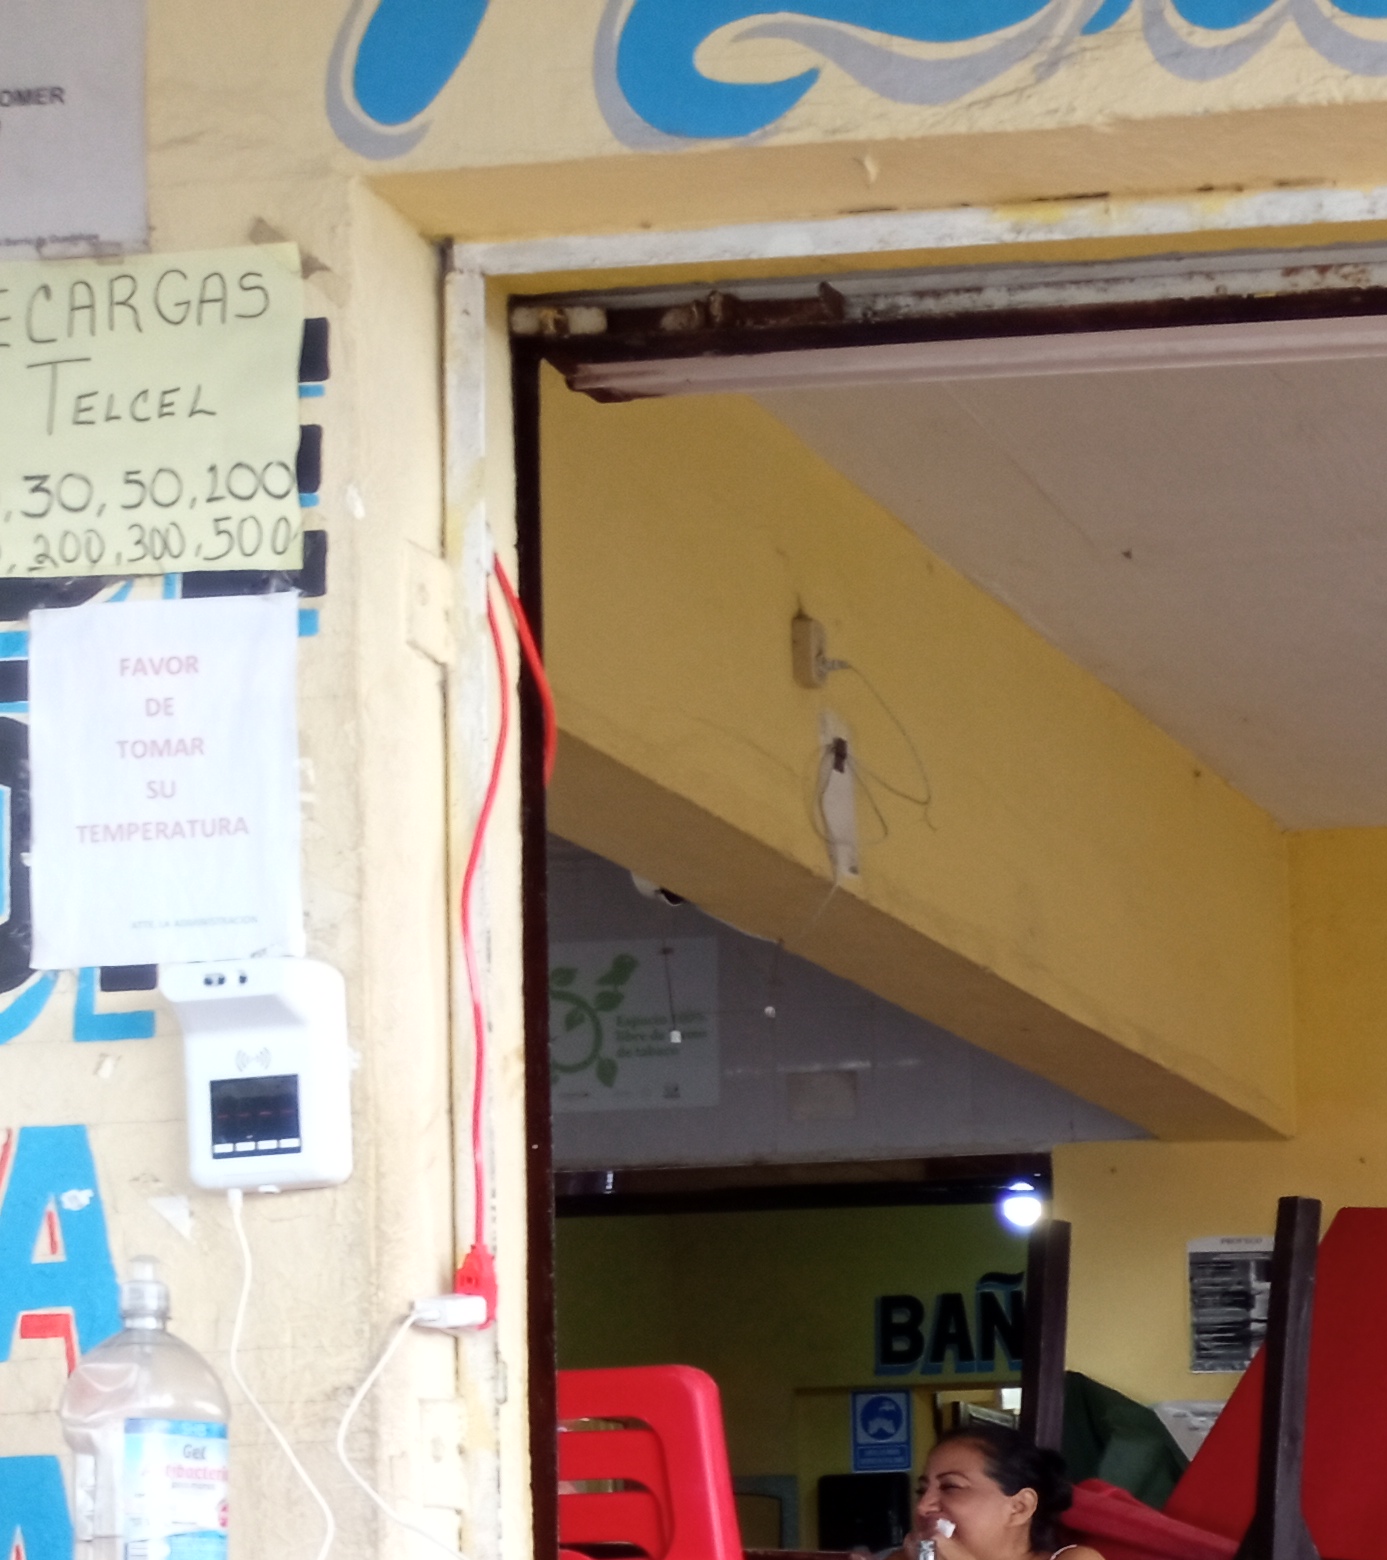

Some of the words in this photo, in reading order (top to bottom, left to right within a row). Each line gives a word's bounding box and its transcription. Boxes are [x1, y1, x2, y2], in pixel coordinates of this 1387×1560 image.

[118, 655, 200, 677] FAVOR
[144, 697, 175, 717] DE
[116, 737, 205, 760] TOMAR
[146, 780, 176, 799] SU
[76, 817, 249, 844] TEMPERATURA
[876, 1271, 1026, 1370] BAÑ
[183, 1443, 206, 1460] Gel
